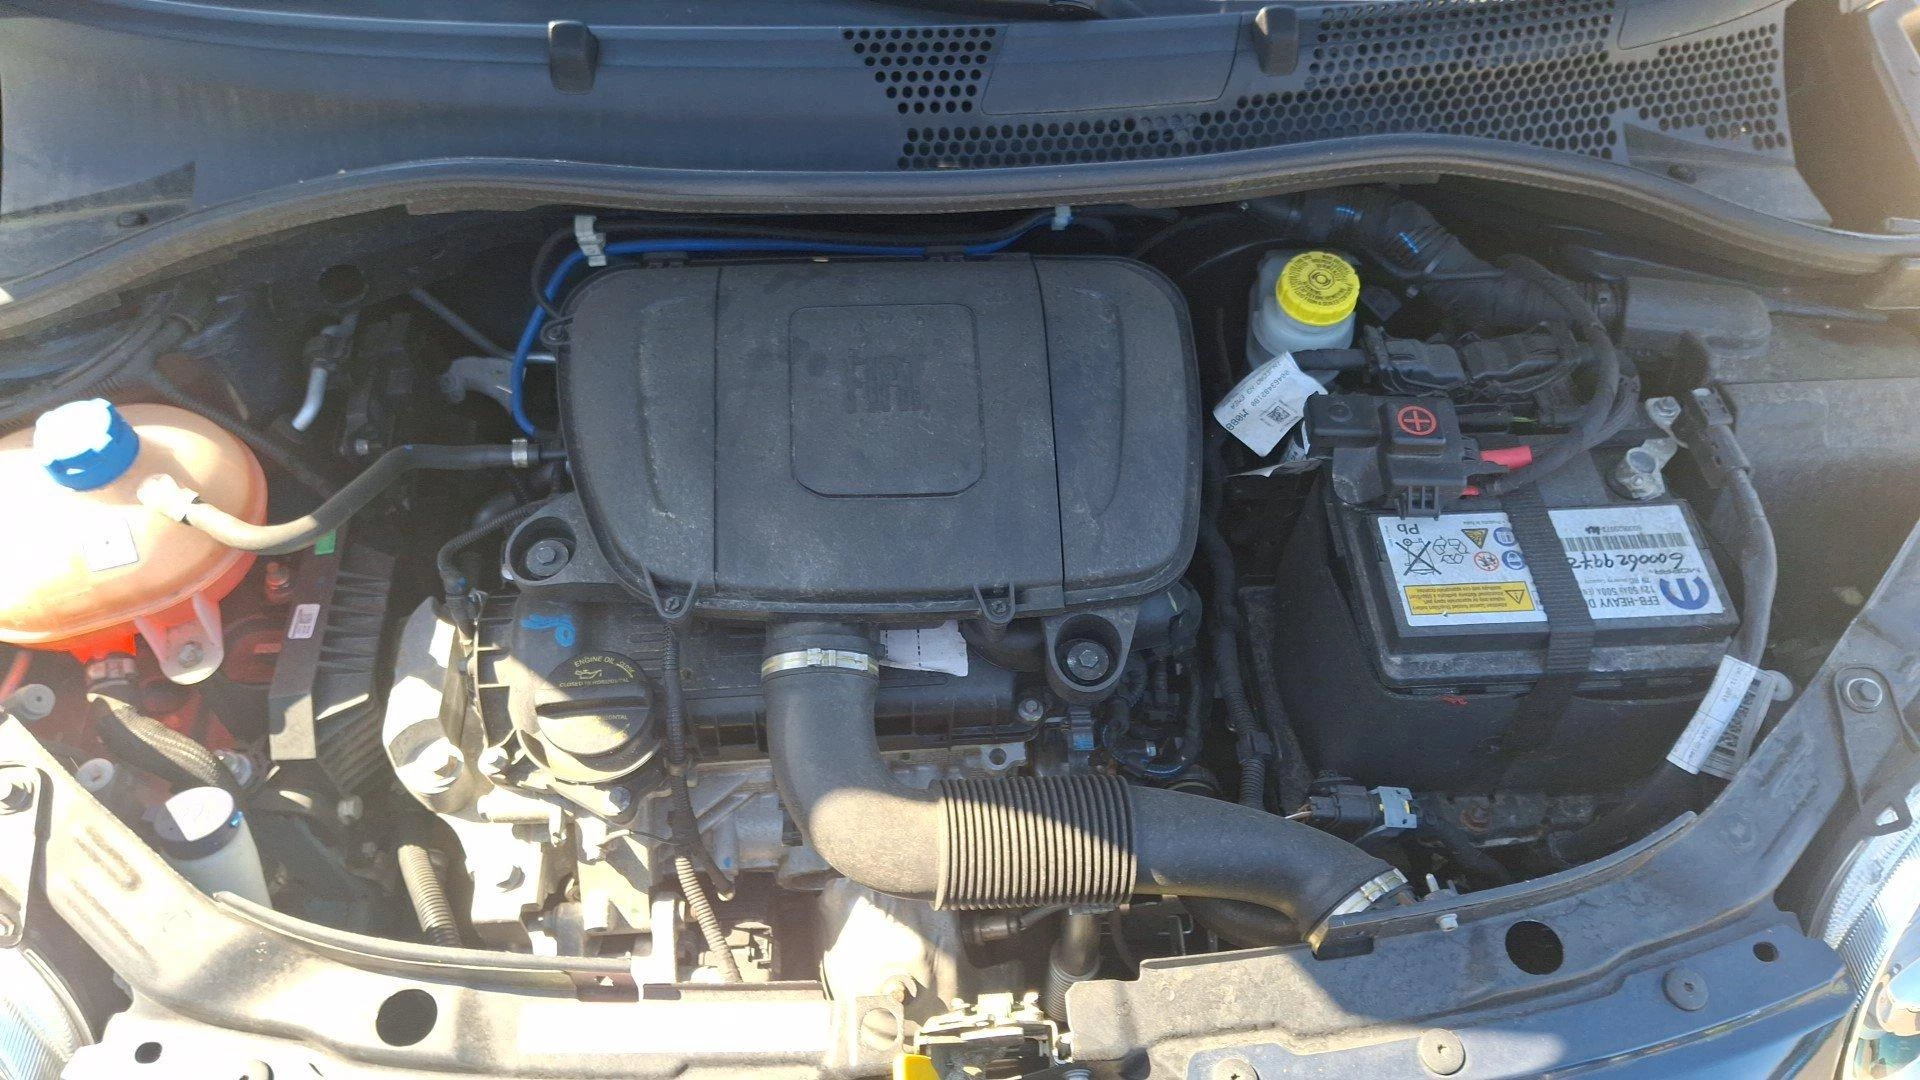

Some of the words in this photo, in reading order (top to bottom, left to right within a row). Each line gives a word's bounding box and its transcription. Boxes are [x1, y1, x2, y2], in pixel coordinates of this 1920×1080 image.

[1396, 523, 1420, 535] Pb
[1600, 596, 1661, 609] EFB-HEAVY
[574, 655, 602, 668] ENGINE
[604, 656, 615, 665] OIL
